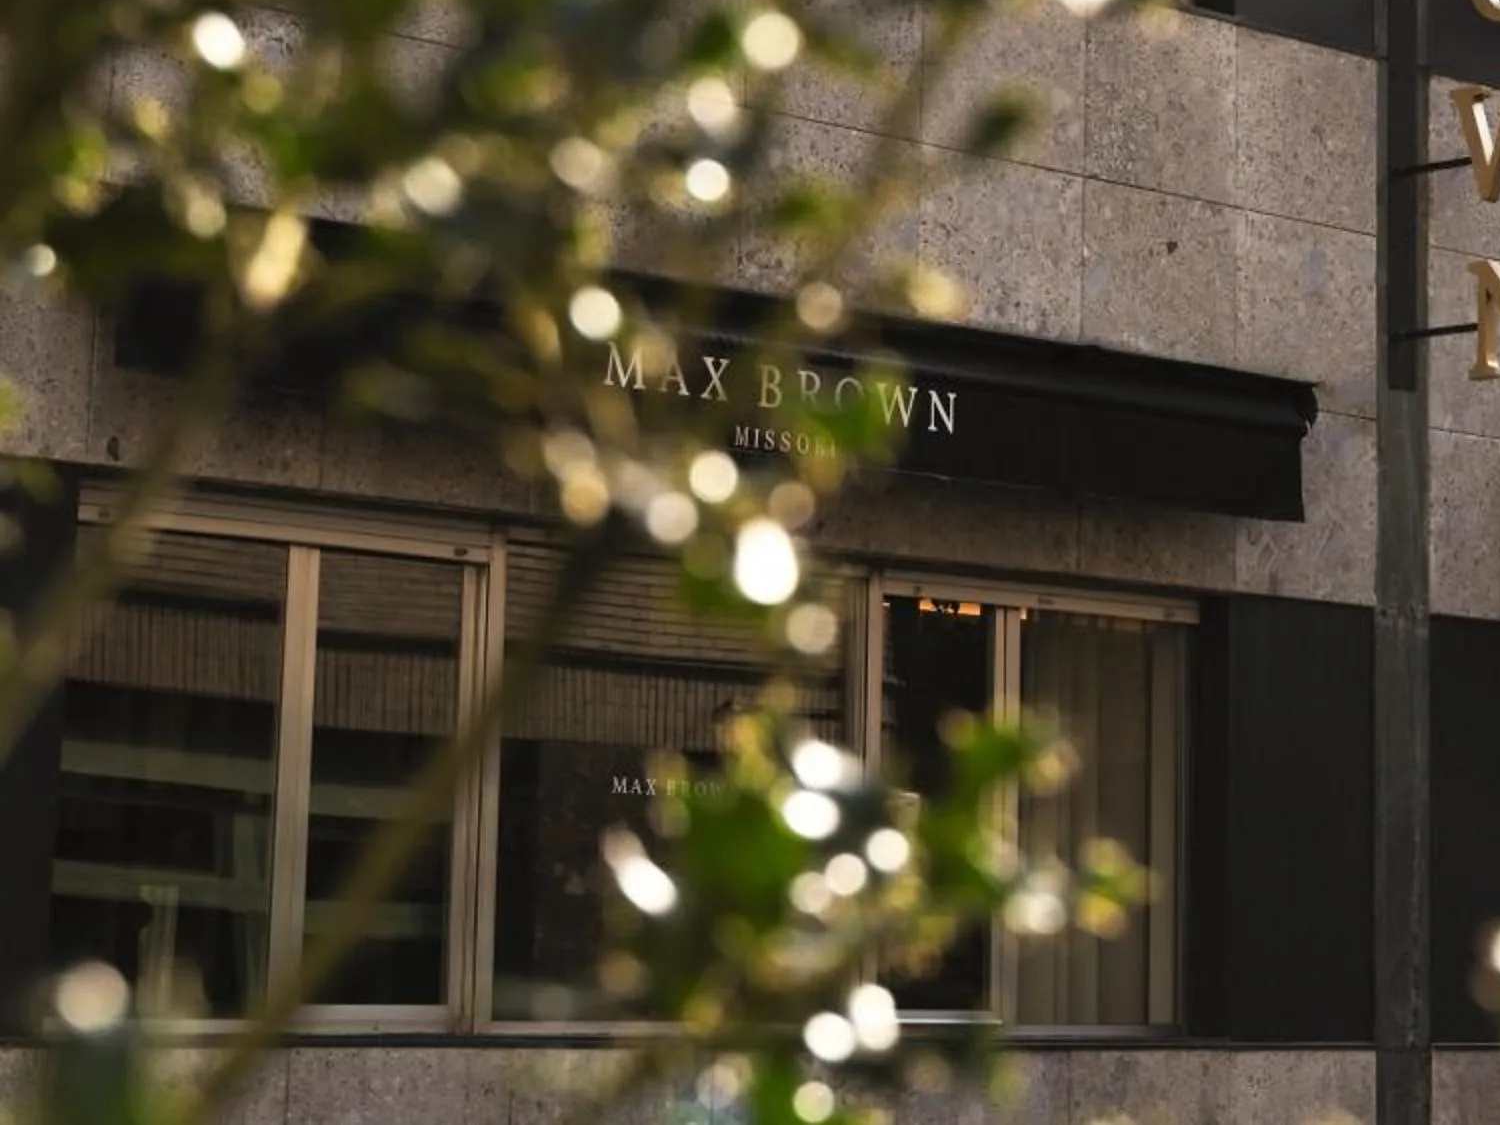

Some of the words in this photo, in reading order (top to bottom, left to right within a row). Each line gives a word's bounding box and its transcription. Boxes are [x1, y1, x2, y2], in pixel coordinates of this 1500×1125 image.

[604, 342, 731, 402] MAX
[757, 363, 957, 435] BROWN
[612, 776, 657, 796] MAX
